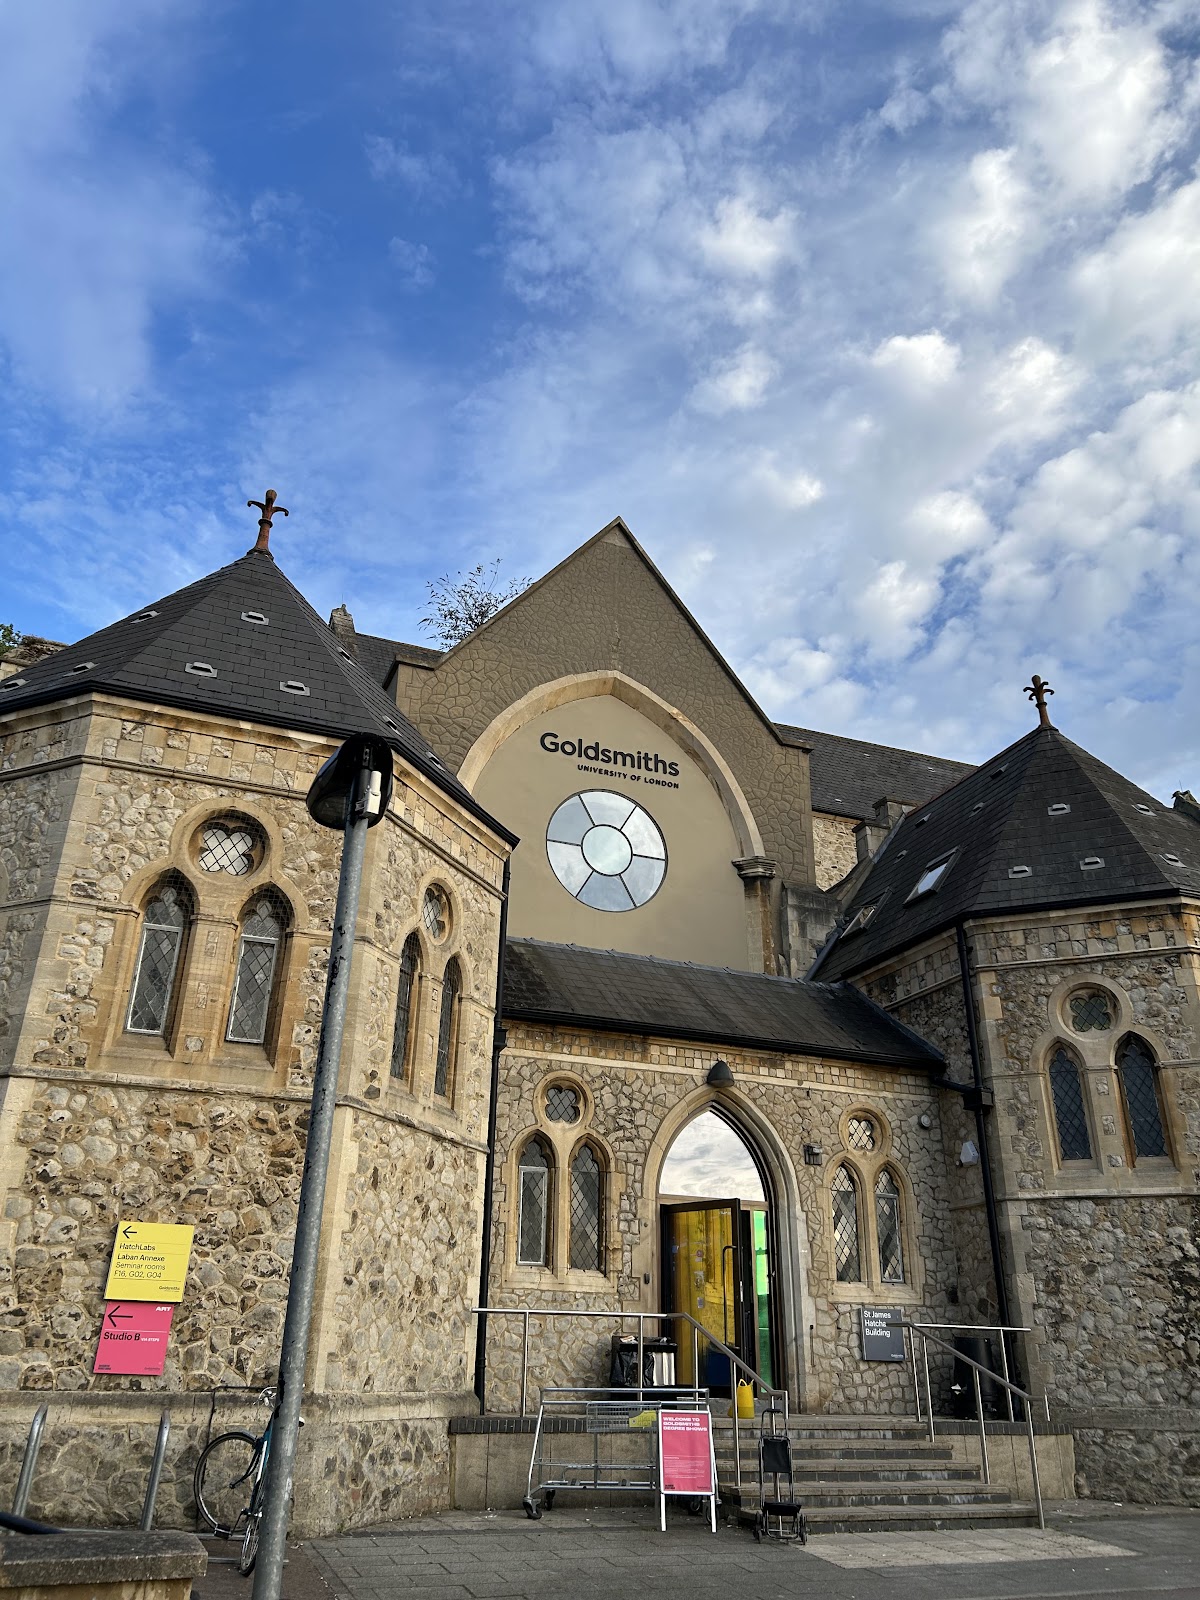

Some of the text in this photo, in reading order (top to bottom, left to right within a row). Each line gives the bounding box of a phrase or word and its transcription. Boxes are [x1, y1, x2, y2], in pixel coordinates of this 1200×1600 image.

[540, 732, 680, 777] Goldsmiths
[577, 764, 680, 789] UNIVERSITY OF LONDON
[119, 1242, 156, 1251] HatchLabs
[103, 1332, 133, 1341] Studio
[866, 1328, 890, 1338] Building
